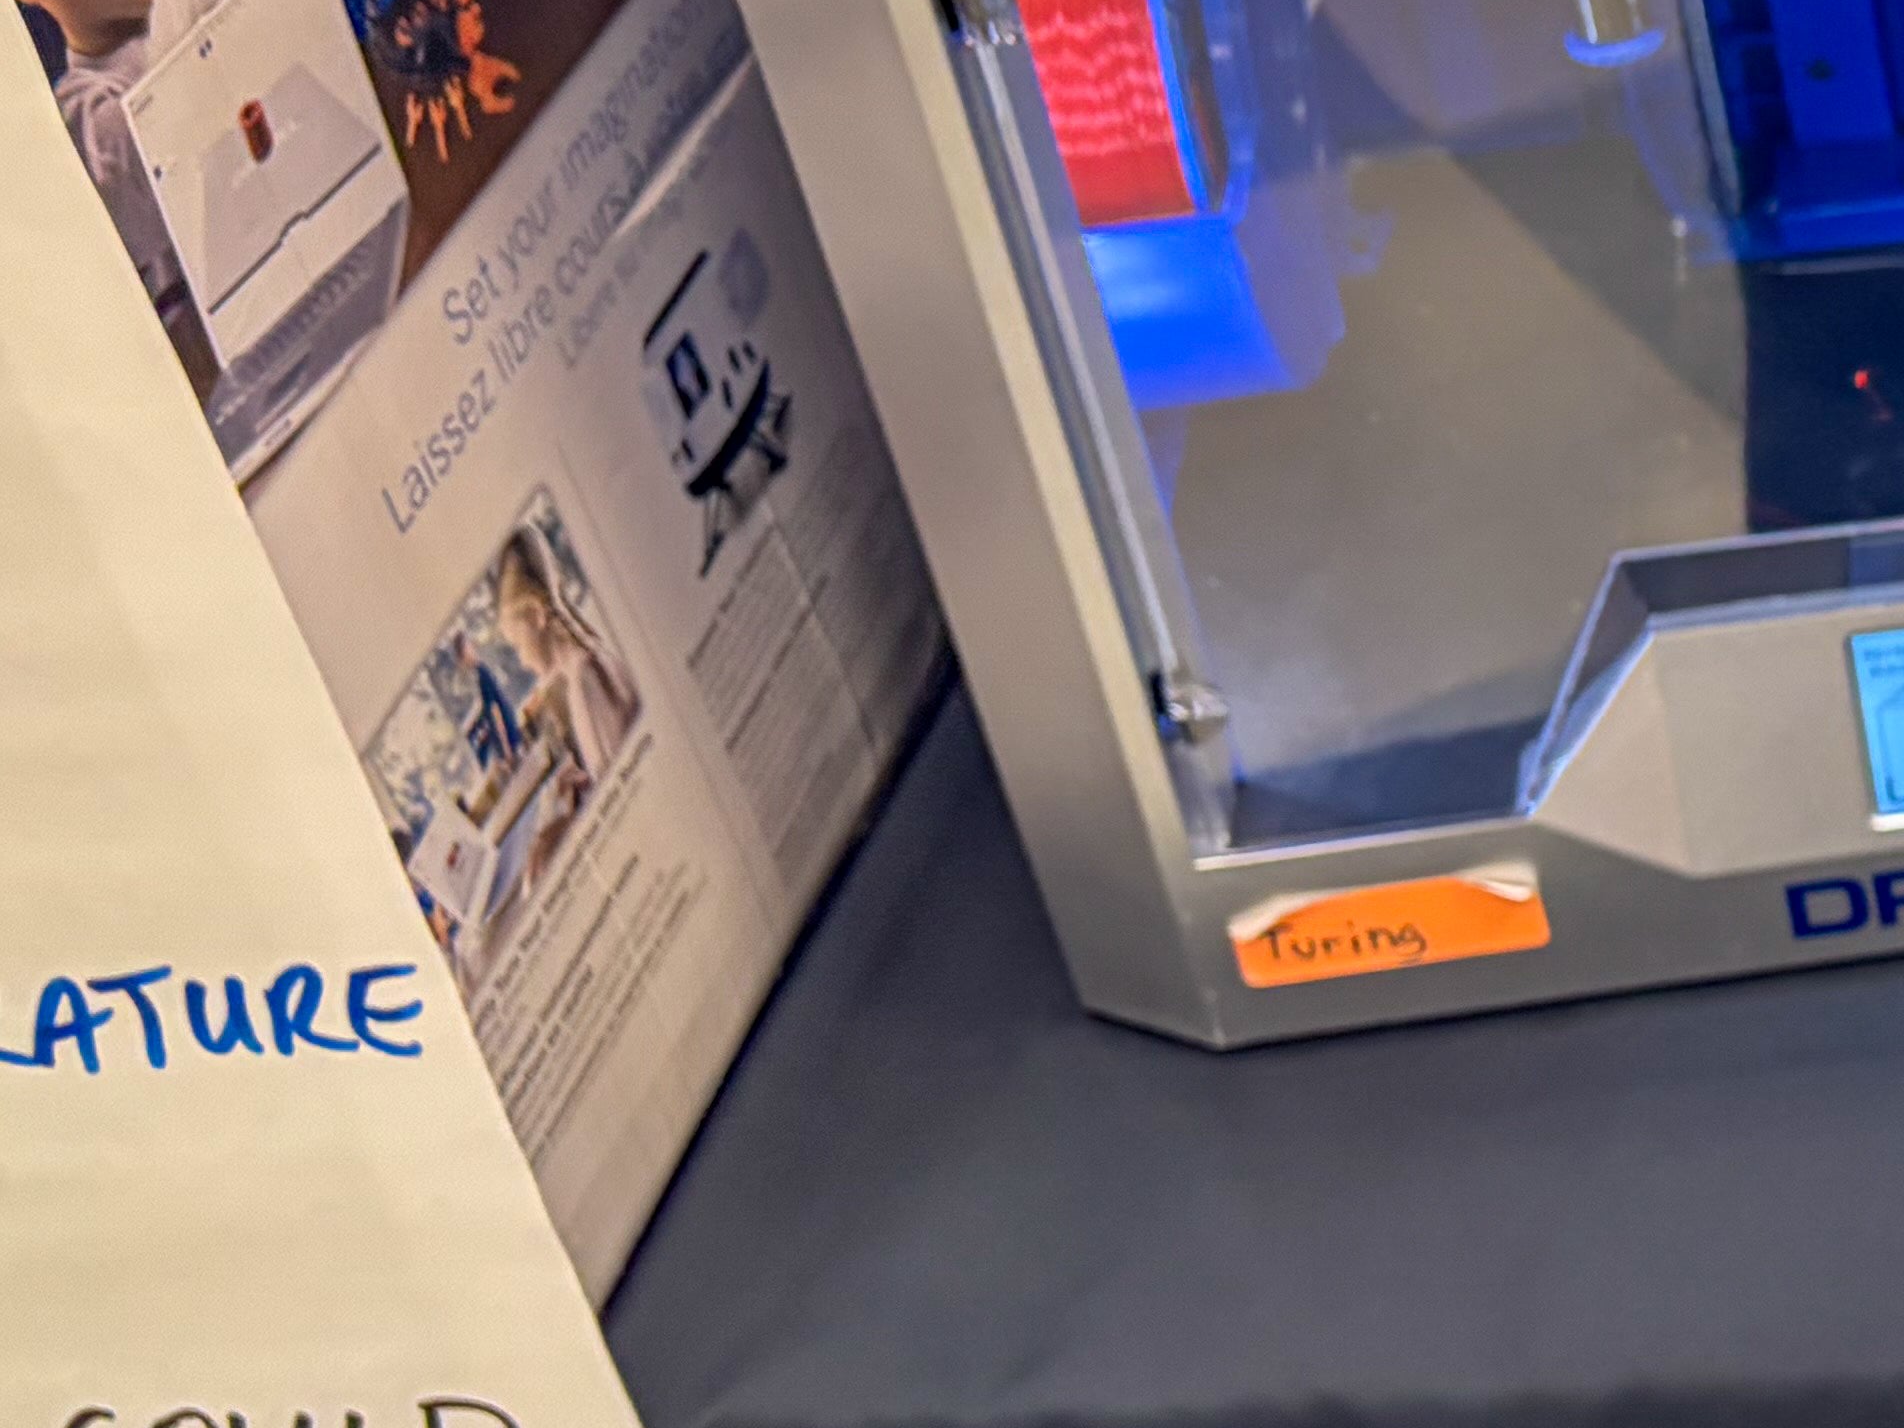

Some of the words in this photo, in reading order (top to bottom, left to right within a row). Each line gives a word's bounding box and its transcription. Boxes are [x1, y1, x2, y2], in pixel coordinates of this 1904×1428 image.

[442, 253, 503, 345] Set
[497, 178, 560, 290] your
[380, 374, 498, 535] Laissez
[487, 284, 558, 386] libre
[1259, 920, 1427, 964] Turing
[0, 964, 423, 1074] ATURE
